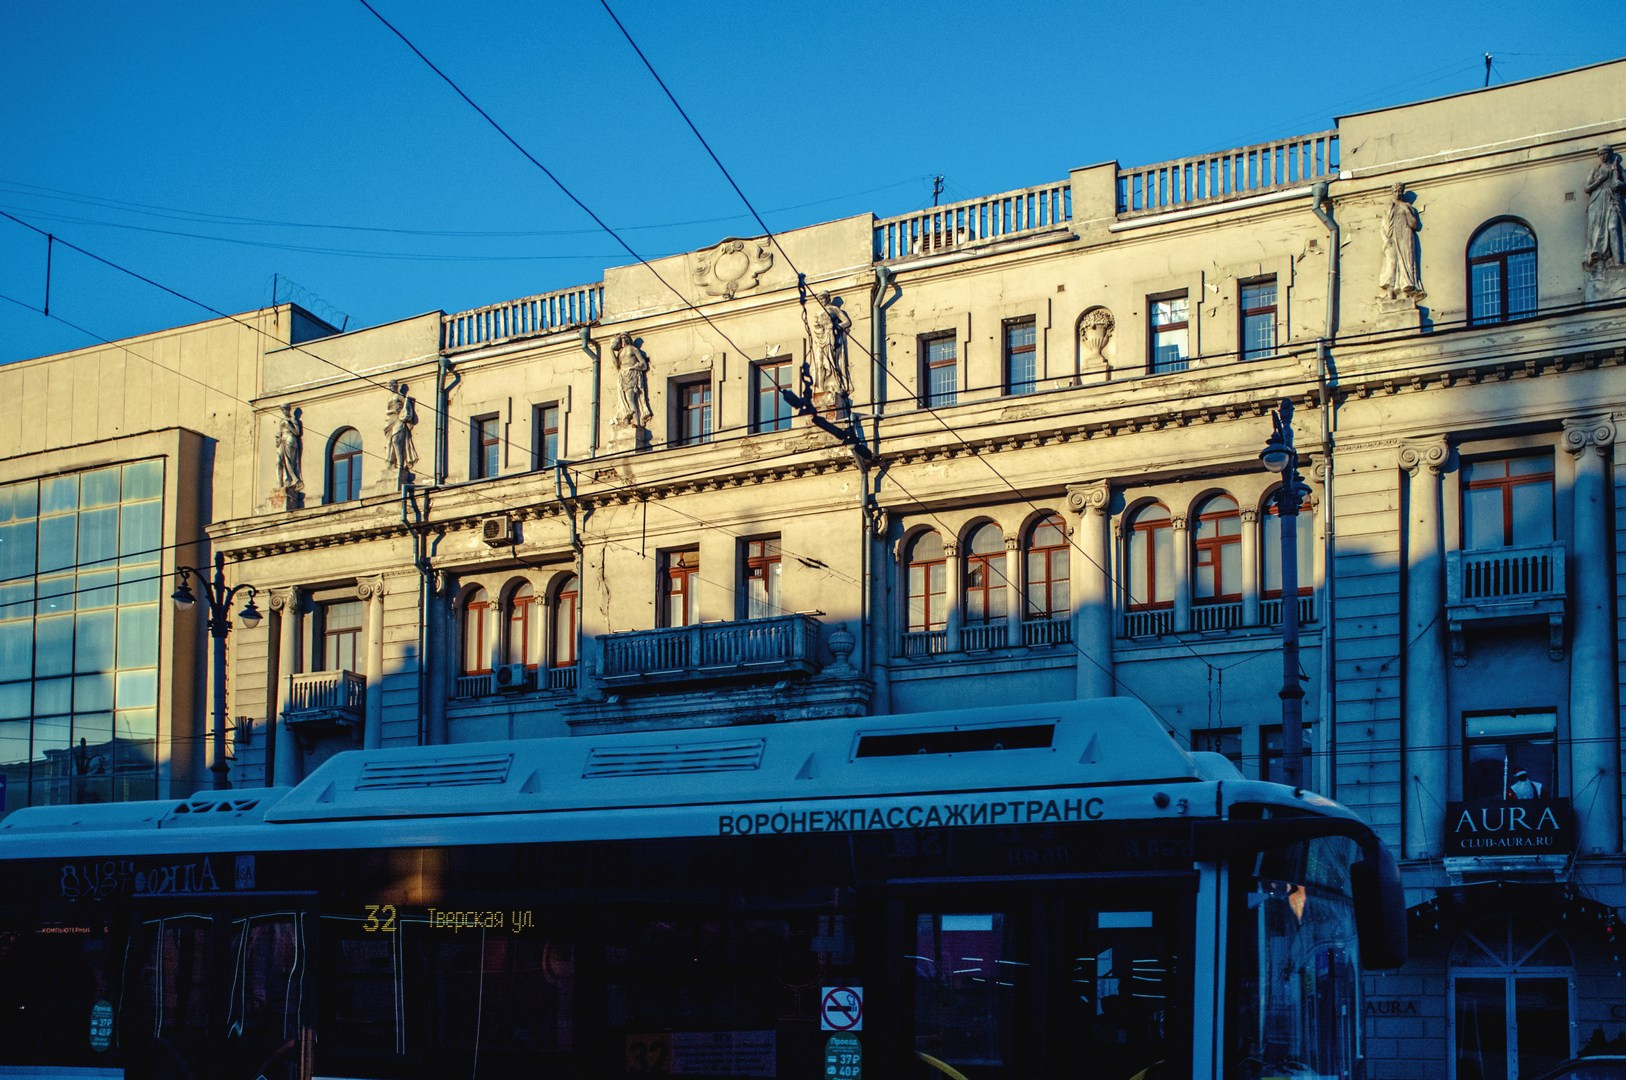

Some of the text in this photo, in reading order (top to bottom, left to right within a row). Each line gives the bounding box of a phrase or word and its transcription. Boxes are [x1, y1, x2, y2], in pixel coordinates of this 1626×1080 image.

[718, 797, 1104, 837] ВОРОНЕЖПАССАЖИРТРАНС
[1454, 806, 1560, 832] AURA
[1461, 836, 1553, 848] CLUB-AURA.RU
[363, 904, 397, 932] 32
[427, 908, 535, 934] Тверская ул.
[1364, 1000, 1416, 1014] AURA
[830, 1037, 858, 1047] Проезд
